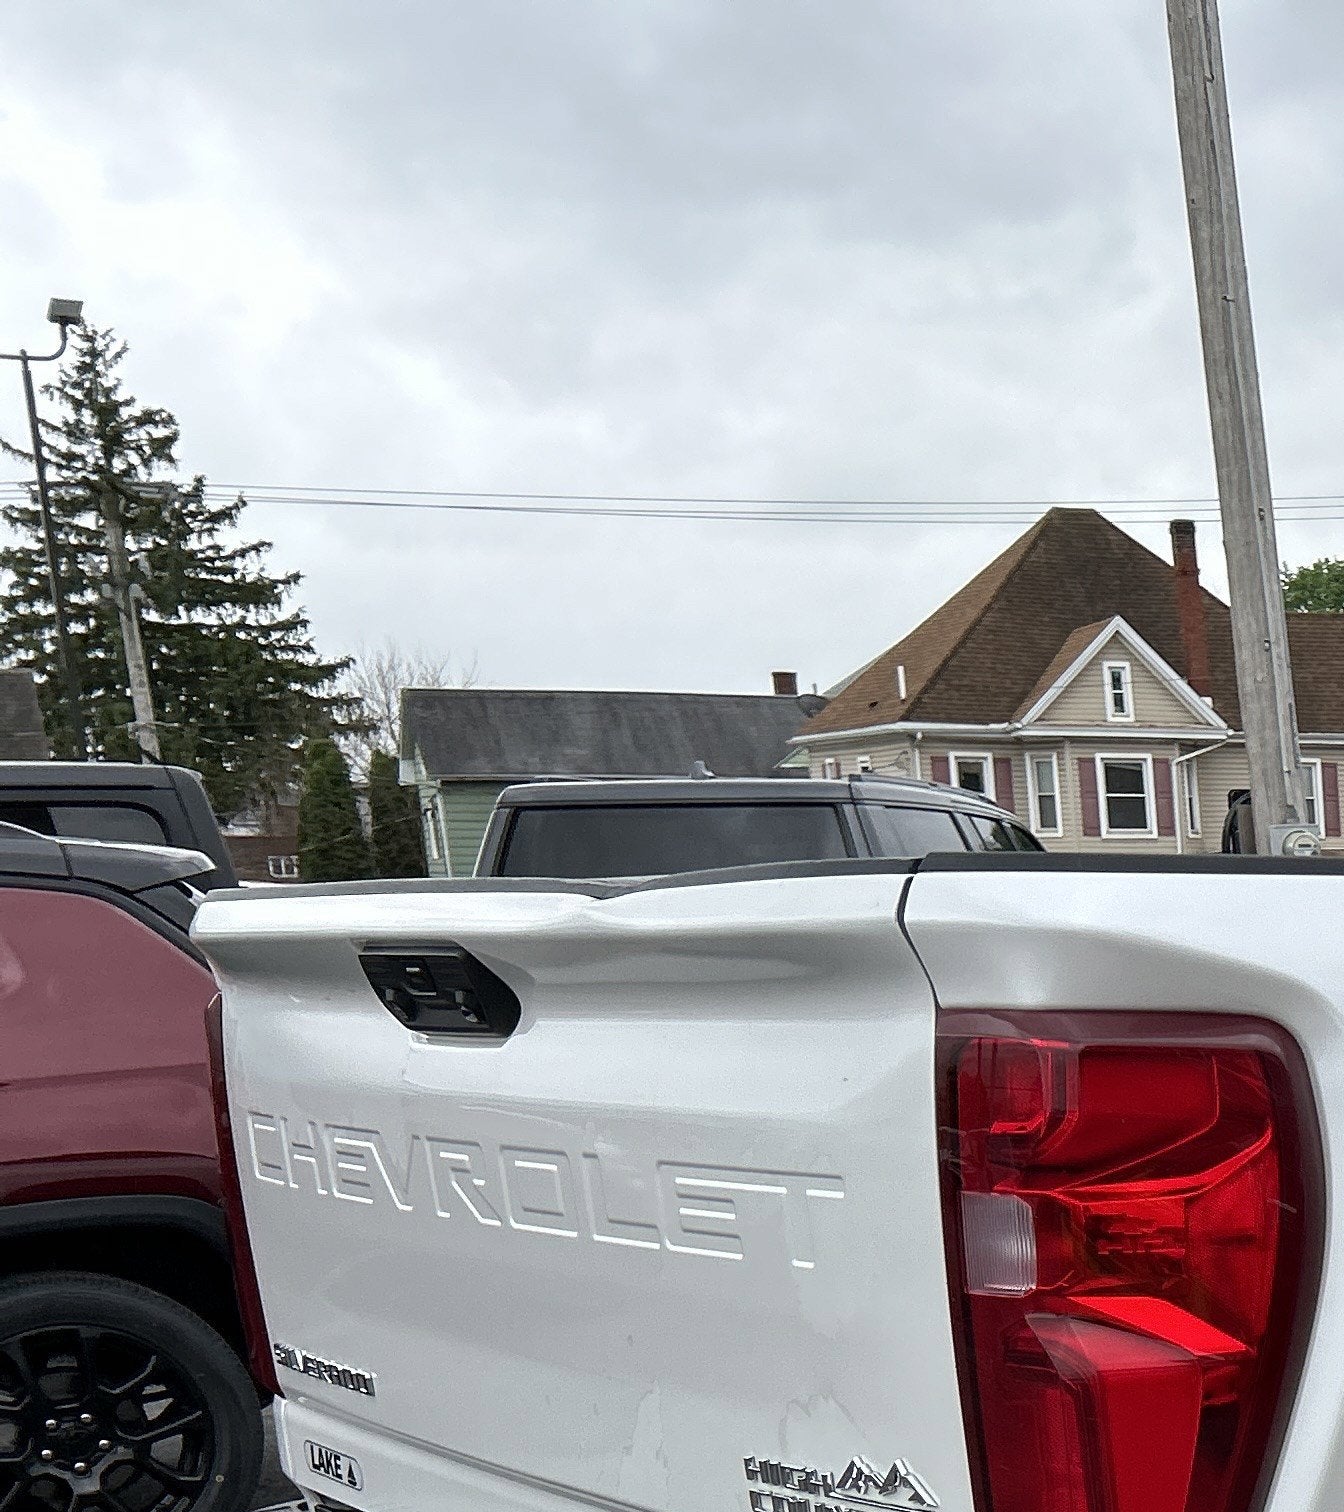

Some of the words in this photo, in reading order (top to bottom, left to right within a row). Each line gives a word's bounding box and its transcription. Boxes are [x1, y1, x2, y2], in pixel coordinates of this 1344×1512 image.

[247, 1110, 845, 1269] CHEVROLET
[310, 1444, 343, 1480] LAKE
[743, 1455, 836, 1497] HIGH
